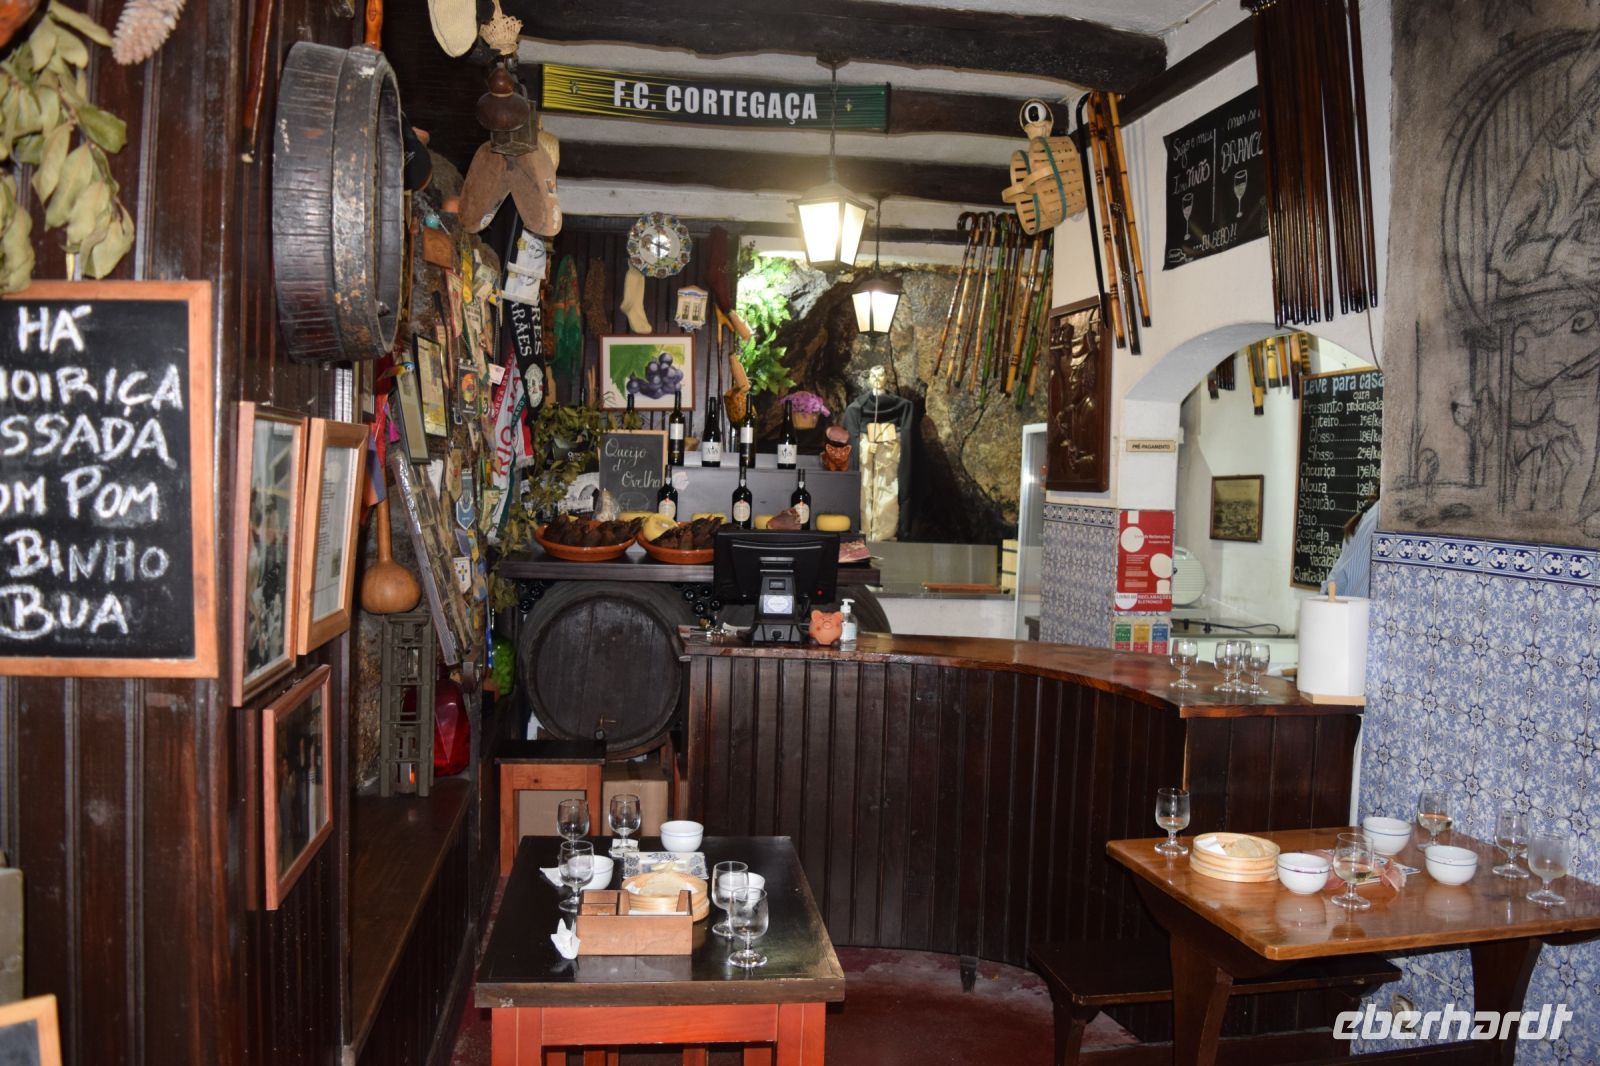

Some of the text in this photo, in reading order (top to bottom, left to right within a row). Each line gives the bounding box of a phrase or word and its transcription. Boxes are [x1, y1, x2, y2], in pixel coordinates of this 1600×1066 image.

[613, 80, 818, 125] F.C. CORTEGAÇA
[18, 305, 92, 353] HÁ
[1331, 374, 1357, 397] para
[605, 437, 648, 467] Queijo
[61, 464, 160, 521] POM
[621, 470, 662, 488] Ovelha
